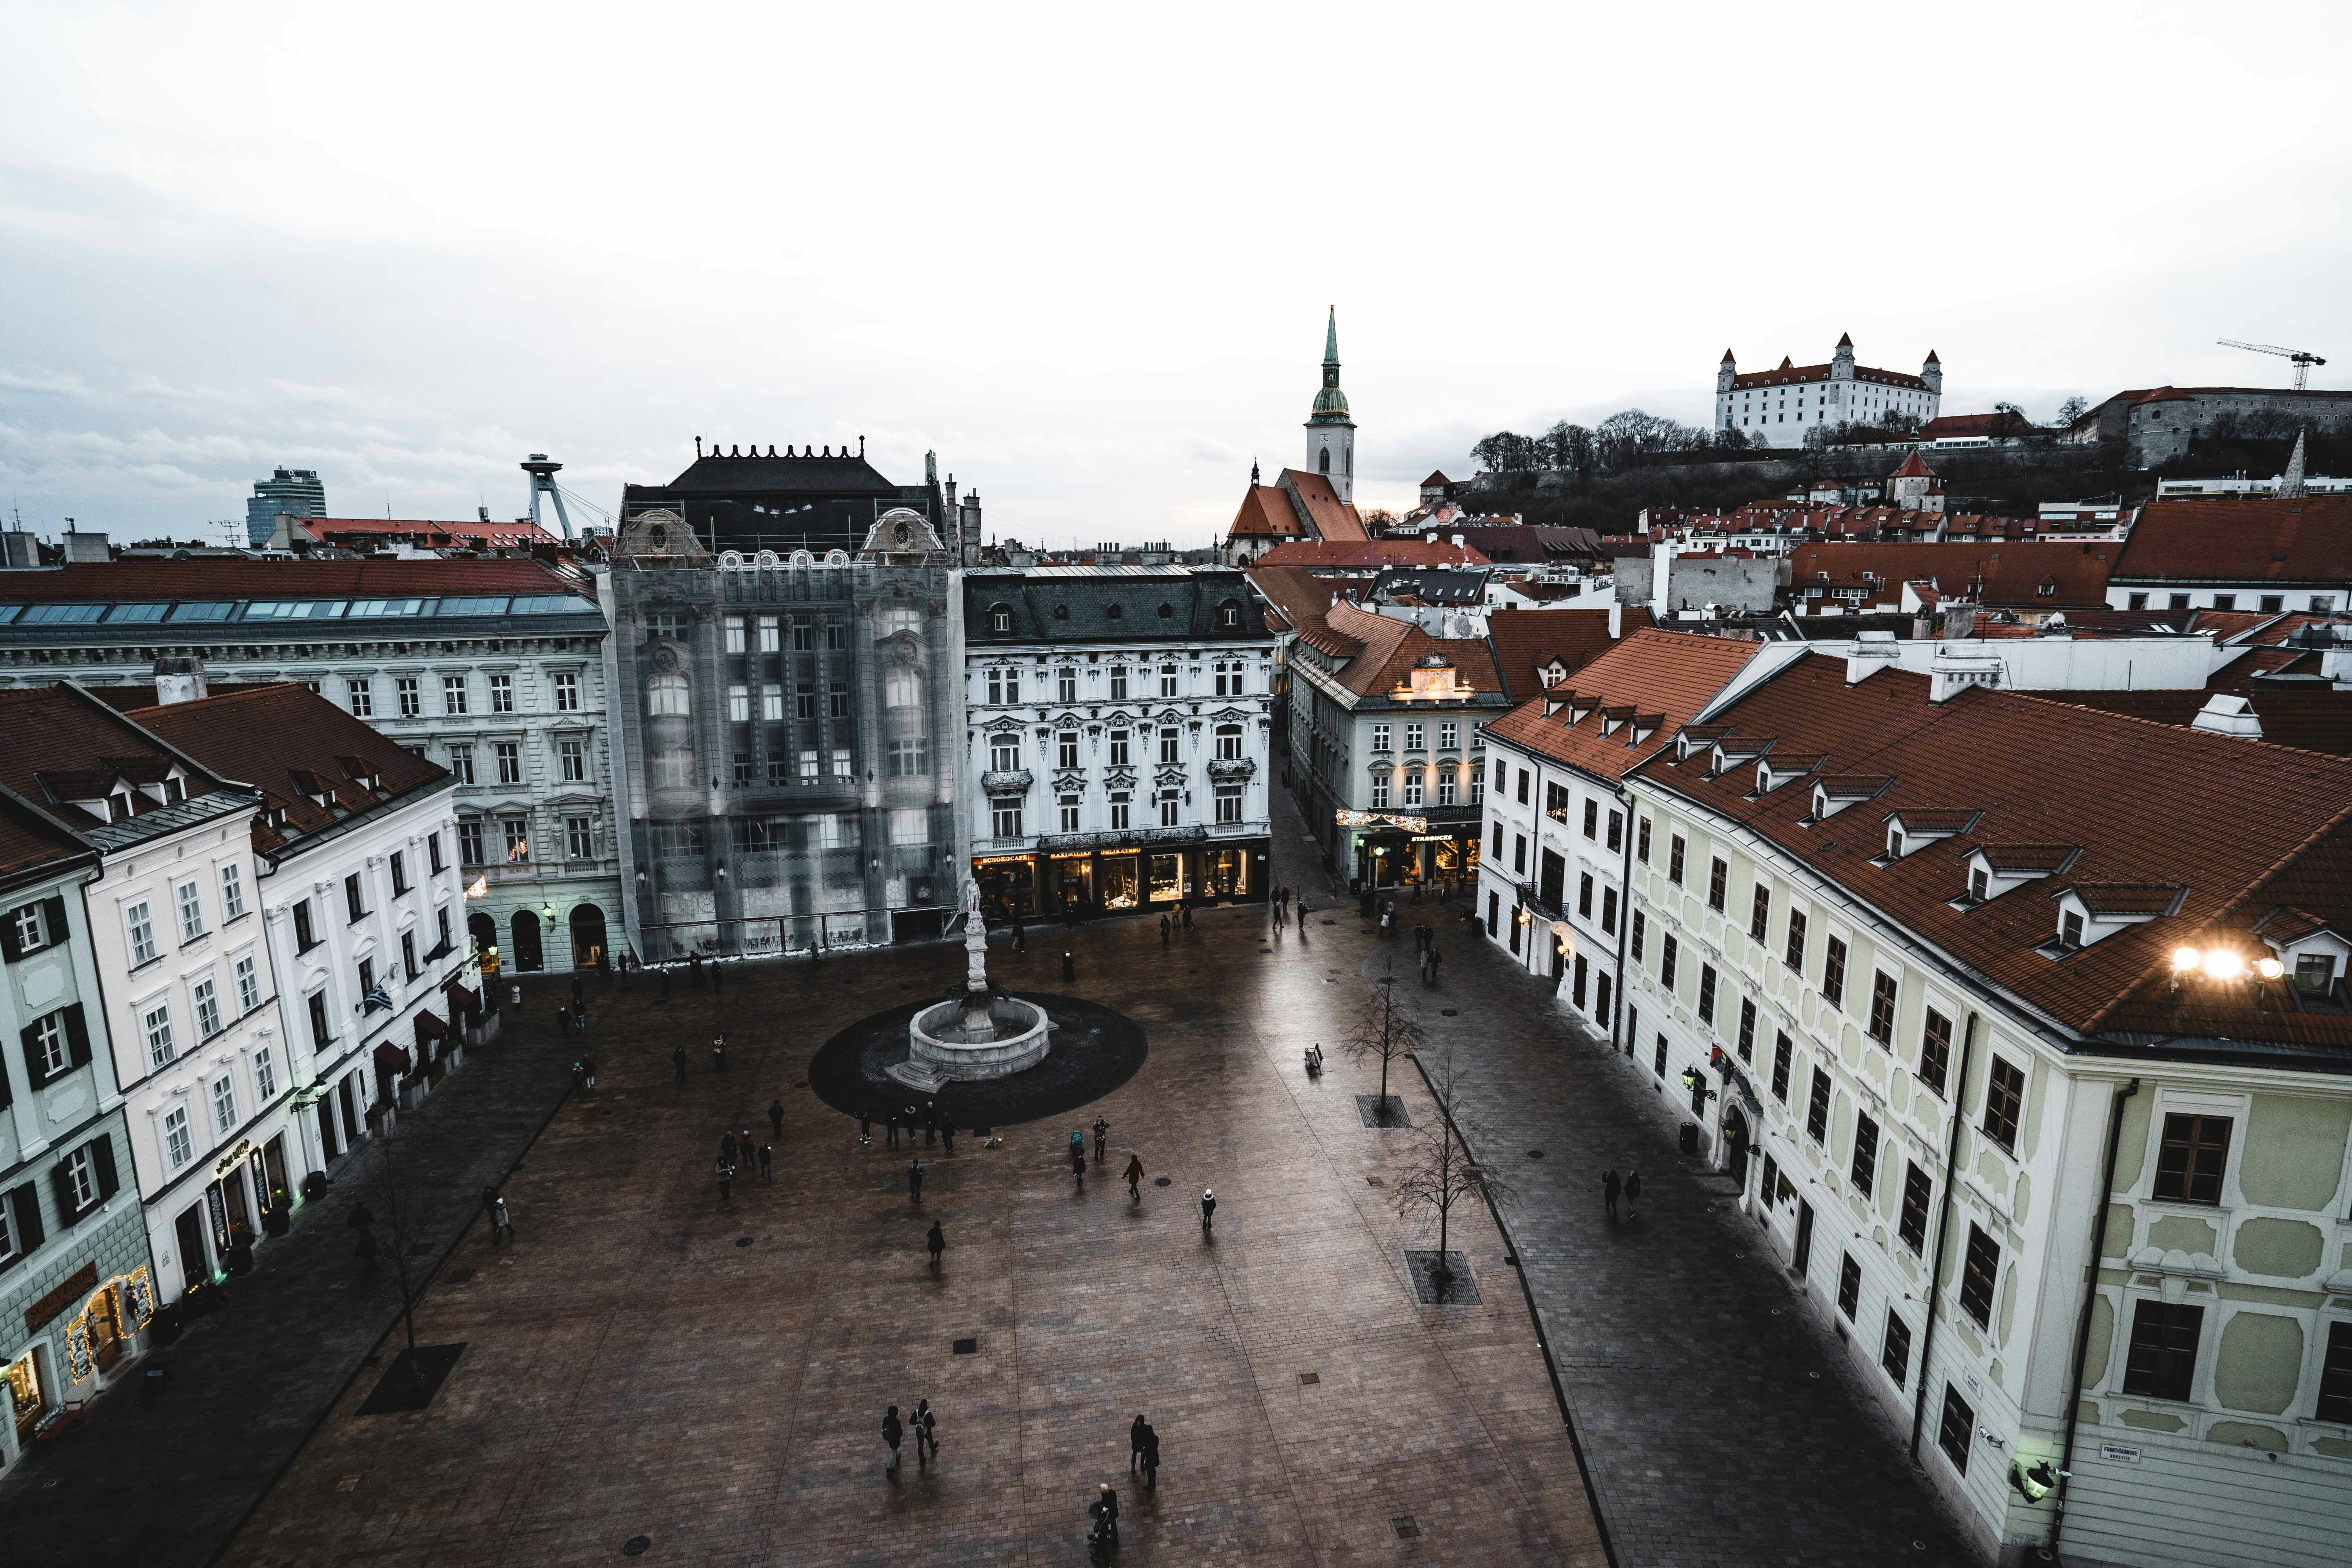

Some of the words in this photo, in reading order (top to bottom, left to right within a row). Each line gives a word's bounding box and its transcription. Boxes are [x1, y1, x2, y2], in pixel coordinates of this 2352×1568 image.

[983, 855, 1027, 864] SCHOKOCAFE
[30, 1268, 94, 1317] SOUVENIRS
[2104, 1446, 2138, 1456] FRANTIŠKÁNSKE
